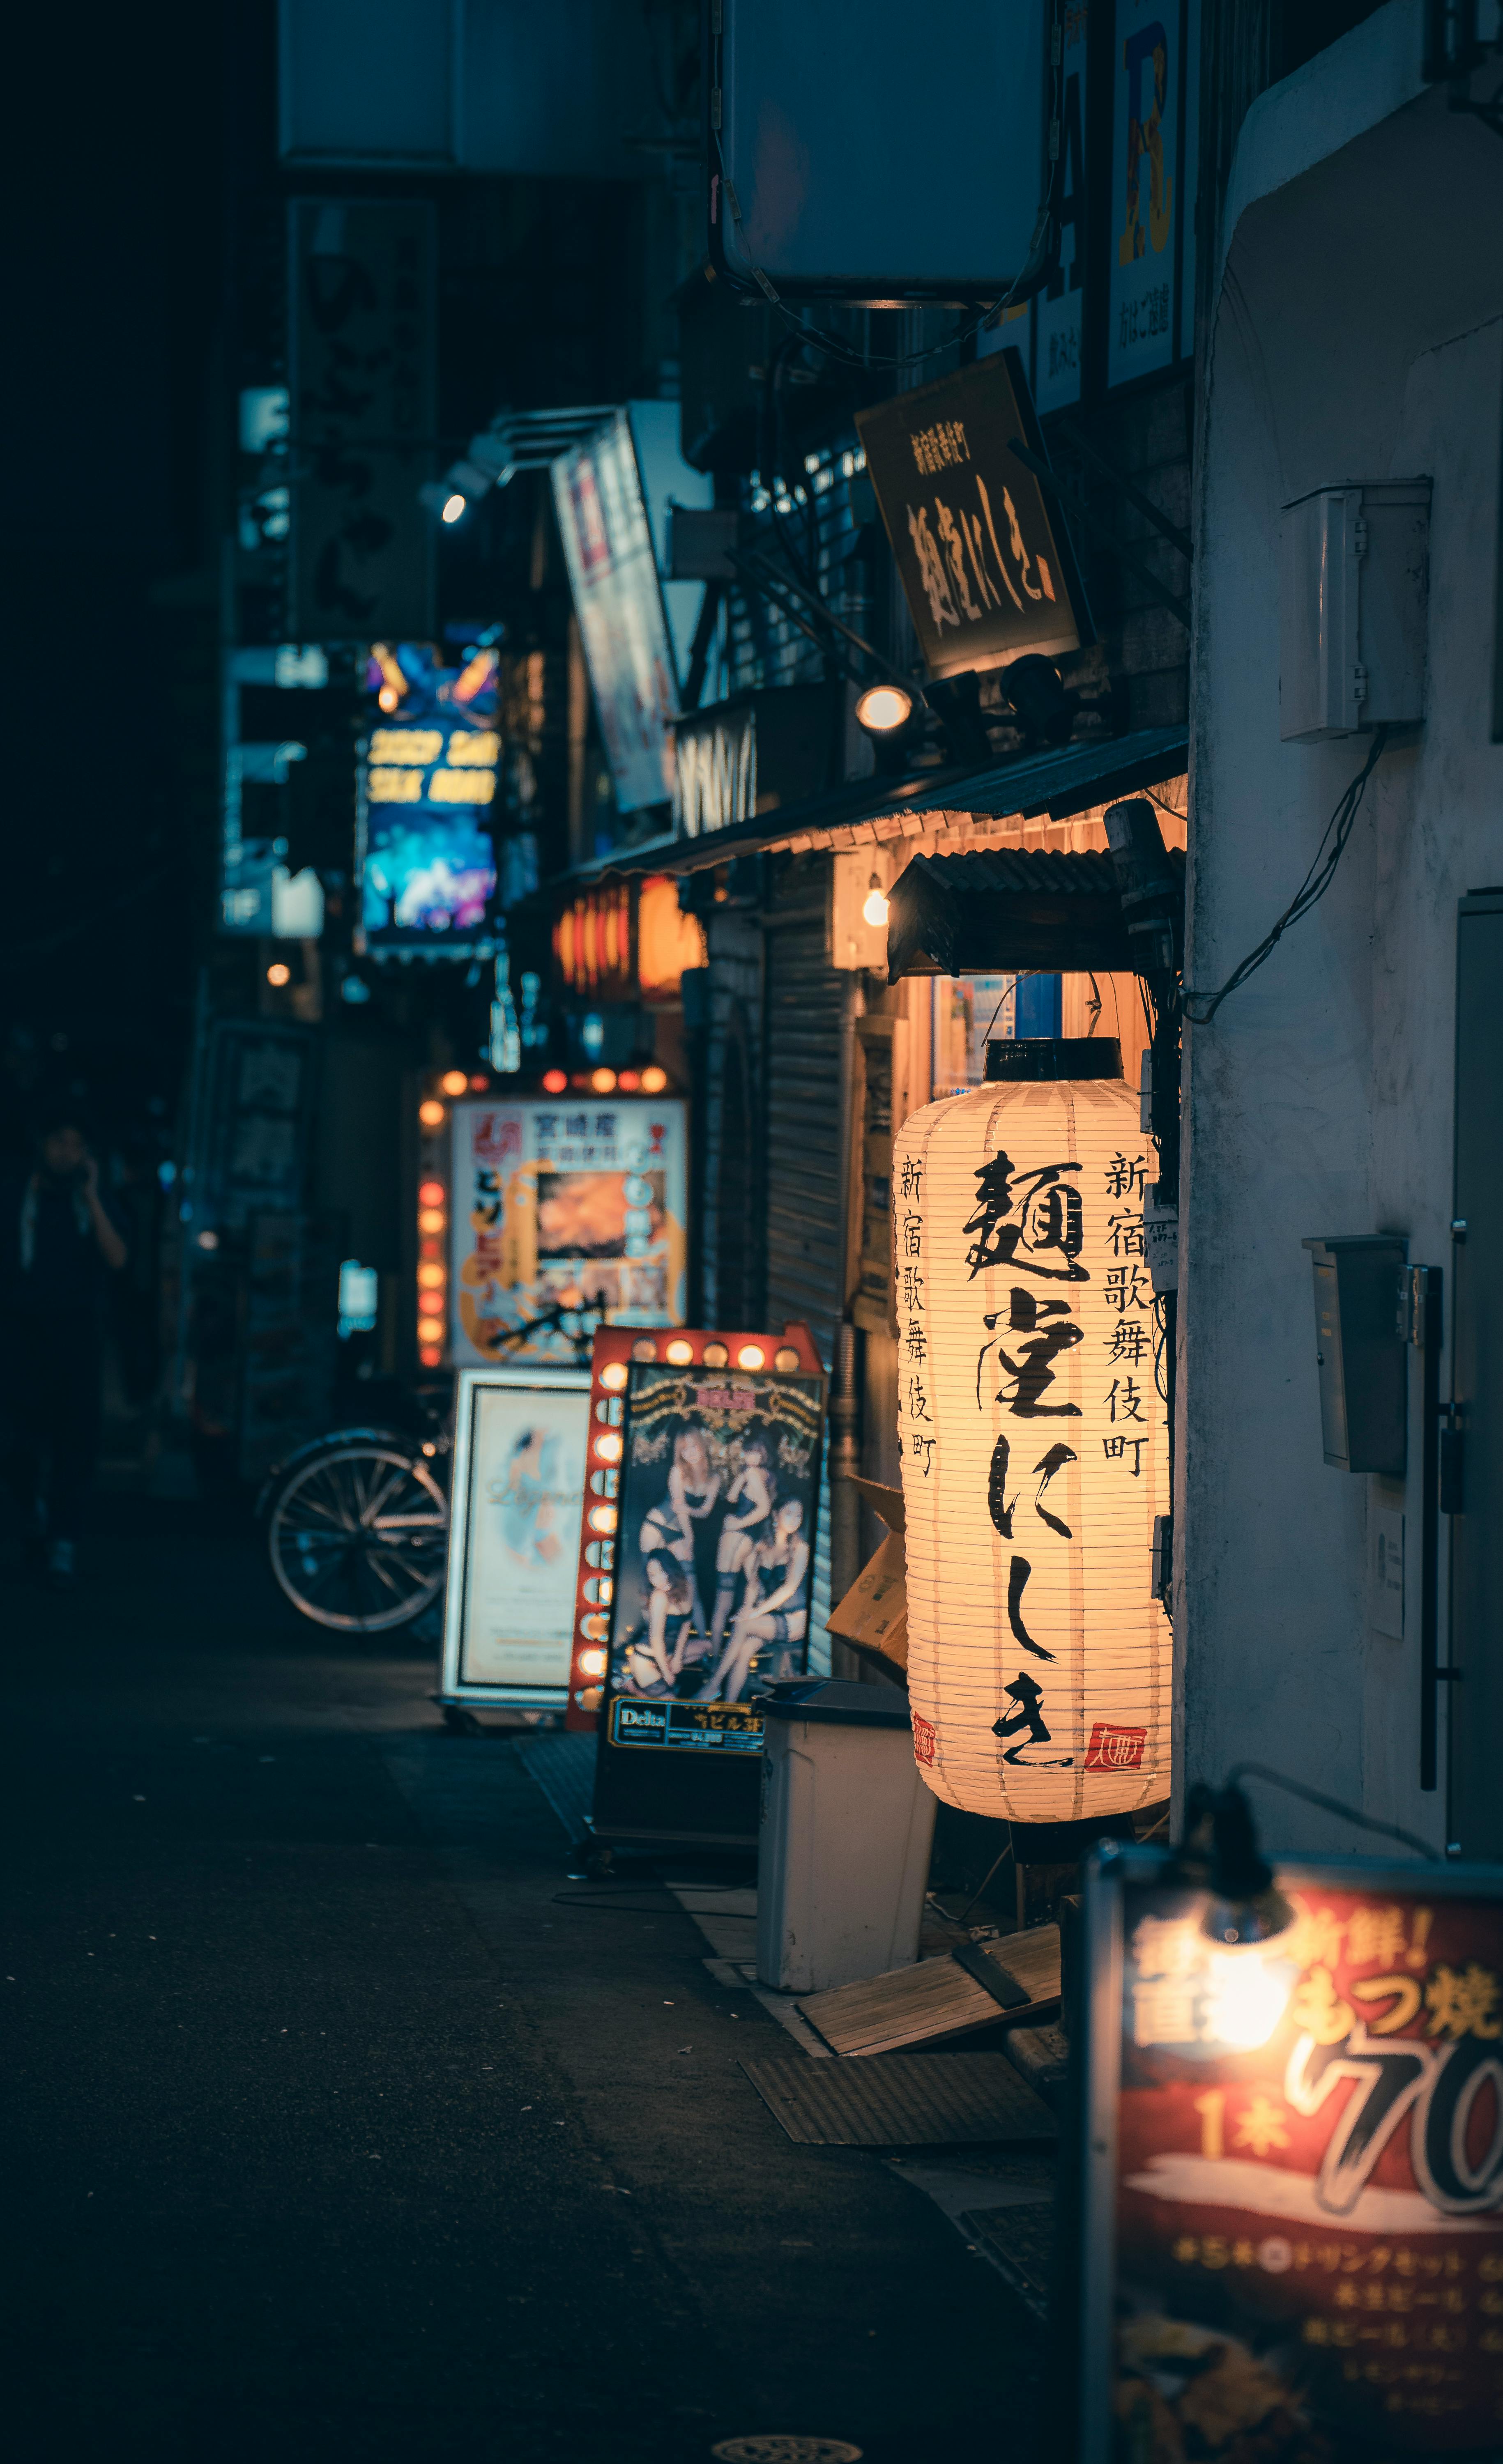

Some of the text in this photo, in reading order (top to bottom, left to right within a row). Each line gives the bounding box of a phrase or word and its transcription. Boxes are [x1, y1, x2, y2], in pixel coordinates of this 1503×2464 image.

[900, 1154, 937, 1477] 新宿歌舞伎町
[1103, 1151, 1151, 1477] 新宿歌舞伎町
[621, 1708, 666, 1726] Delta
